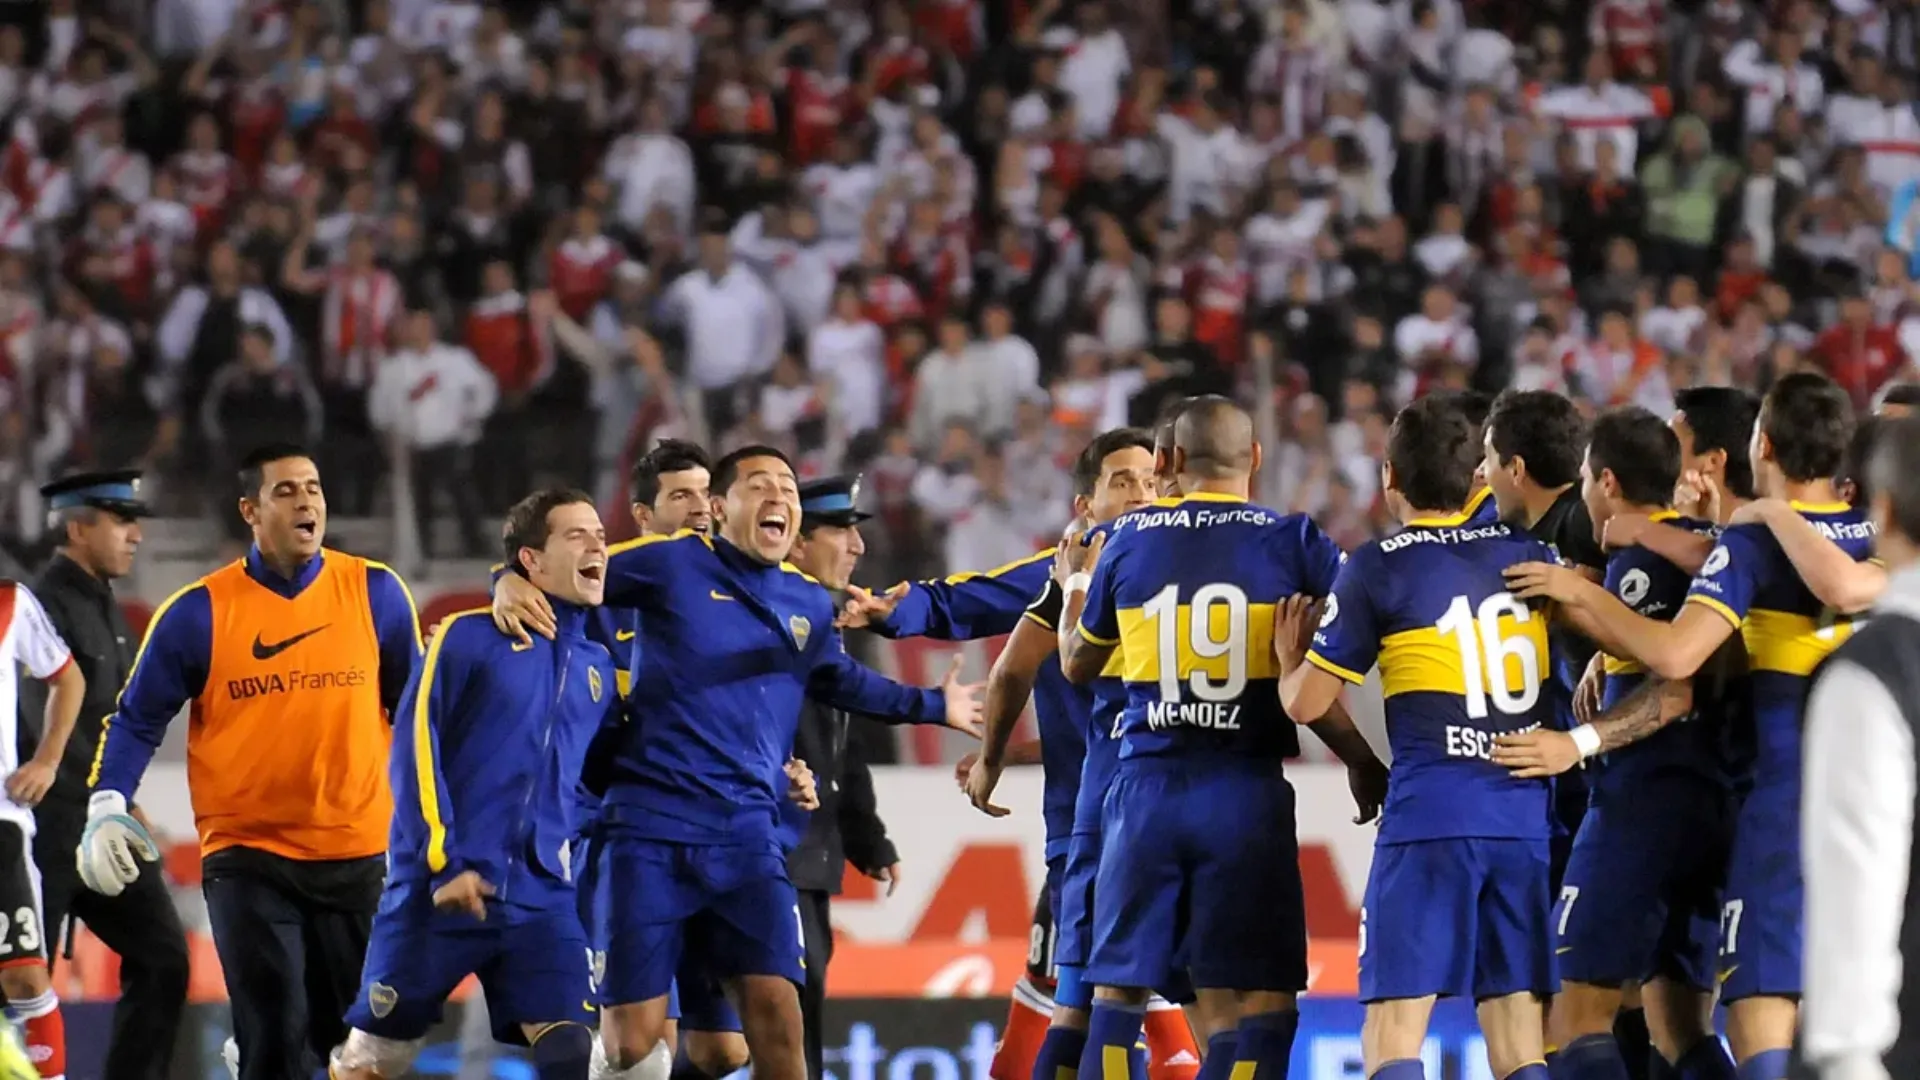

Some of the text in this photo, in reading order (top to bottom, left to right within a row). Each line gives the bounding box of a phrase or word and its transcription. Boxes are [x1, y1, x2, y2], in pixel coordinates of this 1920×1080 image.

[1144, 583, 1249, 703] 19
[1436, 592, 1540, 719] 16
[228, 665, 365, 700] BBVA Francés
[1147, 700, 1242, 731] MENDEZ
